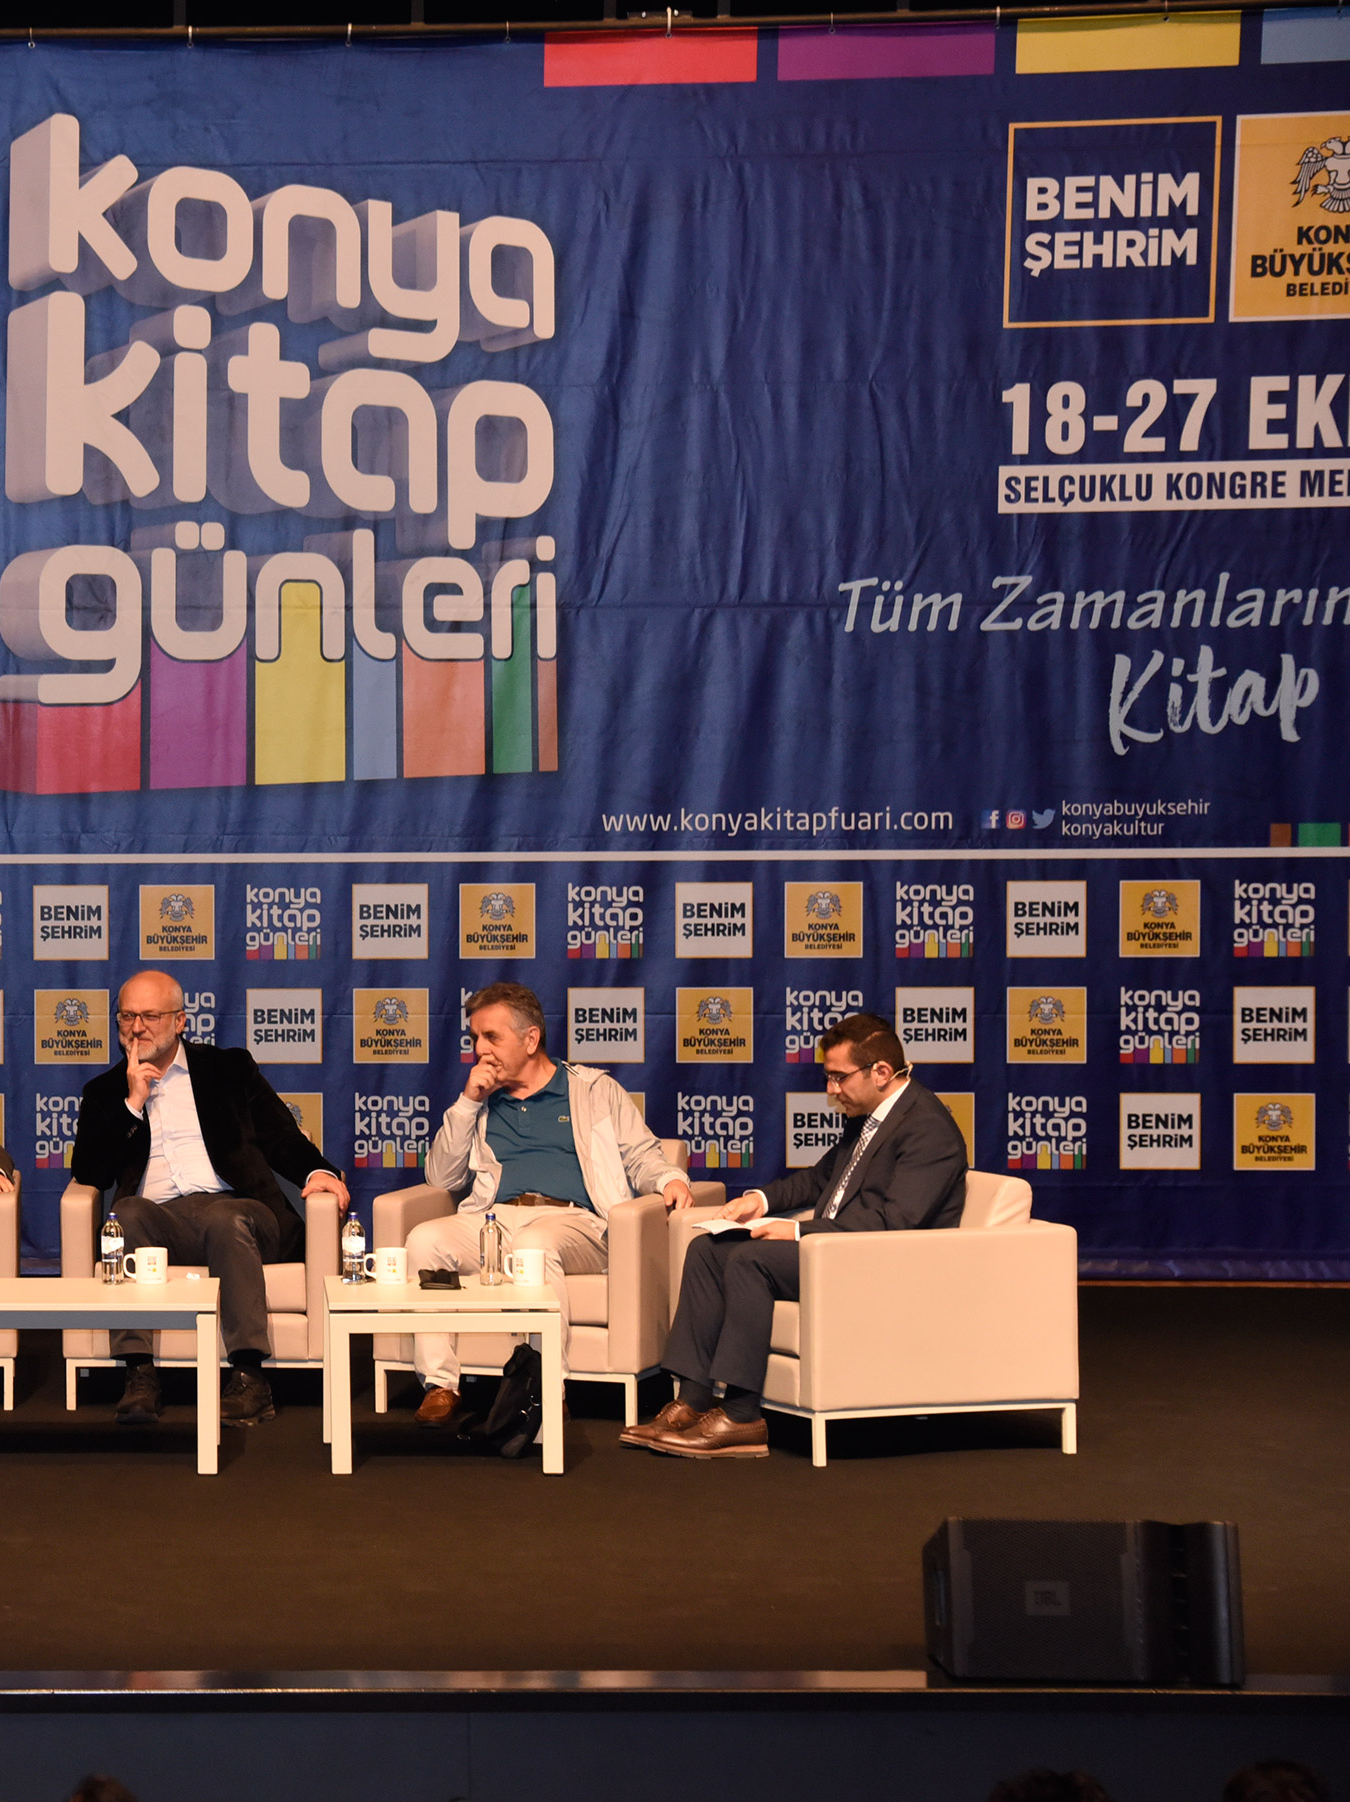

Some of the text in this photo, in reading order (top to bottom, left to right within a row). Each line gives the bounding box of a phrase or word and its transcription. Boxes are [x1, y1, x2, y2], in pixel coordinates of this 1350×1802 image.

[10, 113, 555, 363] konya
[6, 291, 554, 549] kitap
[1002, 373, 1350, 456] 18-27 EK
[1004, 468, 1350, 507] SELÇUKLU KONGRE ME
[0, 521, 557, 704] günleri
[838, 577, 963, 633] Tüm
[1109, 645, 1320, 756] Kitap
[1062, 799, 1210, 819] konyabuyuksehir
[602, 806, 954, 837] www.konyakitapfuari.com
[1062, 819, 1165, 839] konyakultur
[246, 884, 321, 908] konya
[566, 883, 644, 907] konya
[895, 882, 974, 906] konya
[1234, 880, 1315, 904] konya
[246, 904, 321, 931] kitap
[566, 903, 644, 930] kitap
[895, 902, 974, 929] kitap
[1234, 900, 1315, 927] kitap
[162, 923, 192, 934] KONYA
[482, 922, 513, 933] KONYA
[808, 921, 839, 932] KONYA
[1127, 929, 1192, 942] BÜYÜKŞEHİR
[1144, 920, 1175, 930] KONYA
[1234, 925, 1315, 947] günleri
[146, 932, 207, 945] BÜYÜKŞEHİR
[246, 929, 321, 951] günleri
[466, 931, 528, 944] BÜYÜKŞEHİR
[566, 928, 644, 950] günleri
[792, 930, 855, 943] BÜYÜKŞEHİR
[895, 927, 974, 948] günleri
[786, 987, 863, 1011] konya
[1120, 987, 1200, 1011] konya
[699, 1026, 730, 1037] KONYA
[1120, 1007, 1200, 1034] kitap
[41, 1036, 102, 1049] BÜYÜKŞEHİR
[57, 1028, 87, 1038] KONYA
[360, 1036, 421, 1049] BÜYÜKŞEHİR
[376, 1027, 406, 1038] KONYA
[683, 1035, 745, 1048] BÜYÜKŞEHİR
[1014, 1036, 1079, 1049] BÜYÜKŞEHİR
[1031, 1027, 1062, 1037] KONYA
[1120, 1032, 1200, 1054] günleri
[354, 1092, 430, 1116] konya
[677, 1092, 754, 1116] konya
[1008, 1093, 1087, 1117] konya
[354, 1112, 430, 1139] kitap
[677, 1112, 754, 1139] kitap
[1008, 1113, 1087, 1140] kitap
[354, 1137, 430, 1158] günleri
[1008, 1138, 1087, 1160] günleri
[1241, 1142, 1307, 1155] BÜYÜKŞEHİR
[1258, 1133, 1290, 1143] KONYA
